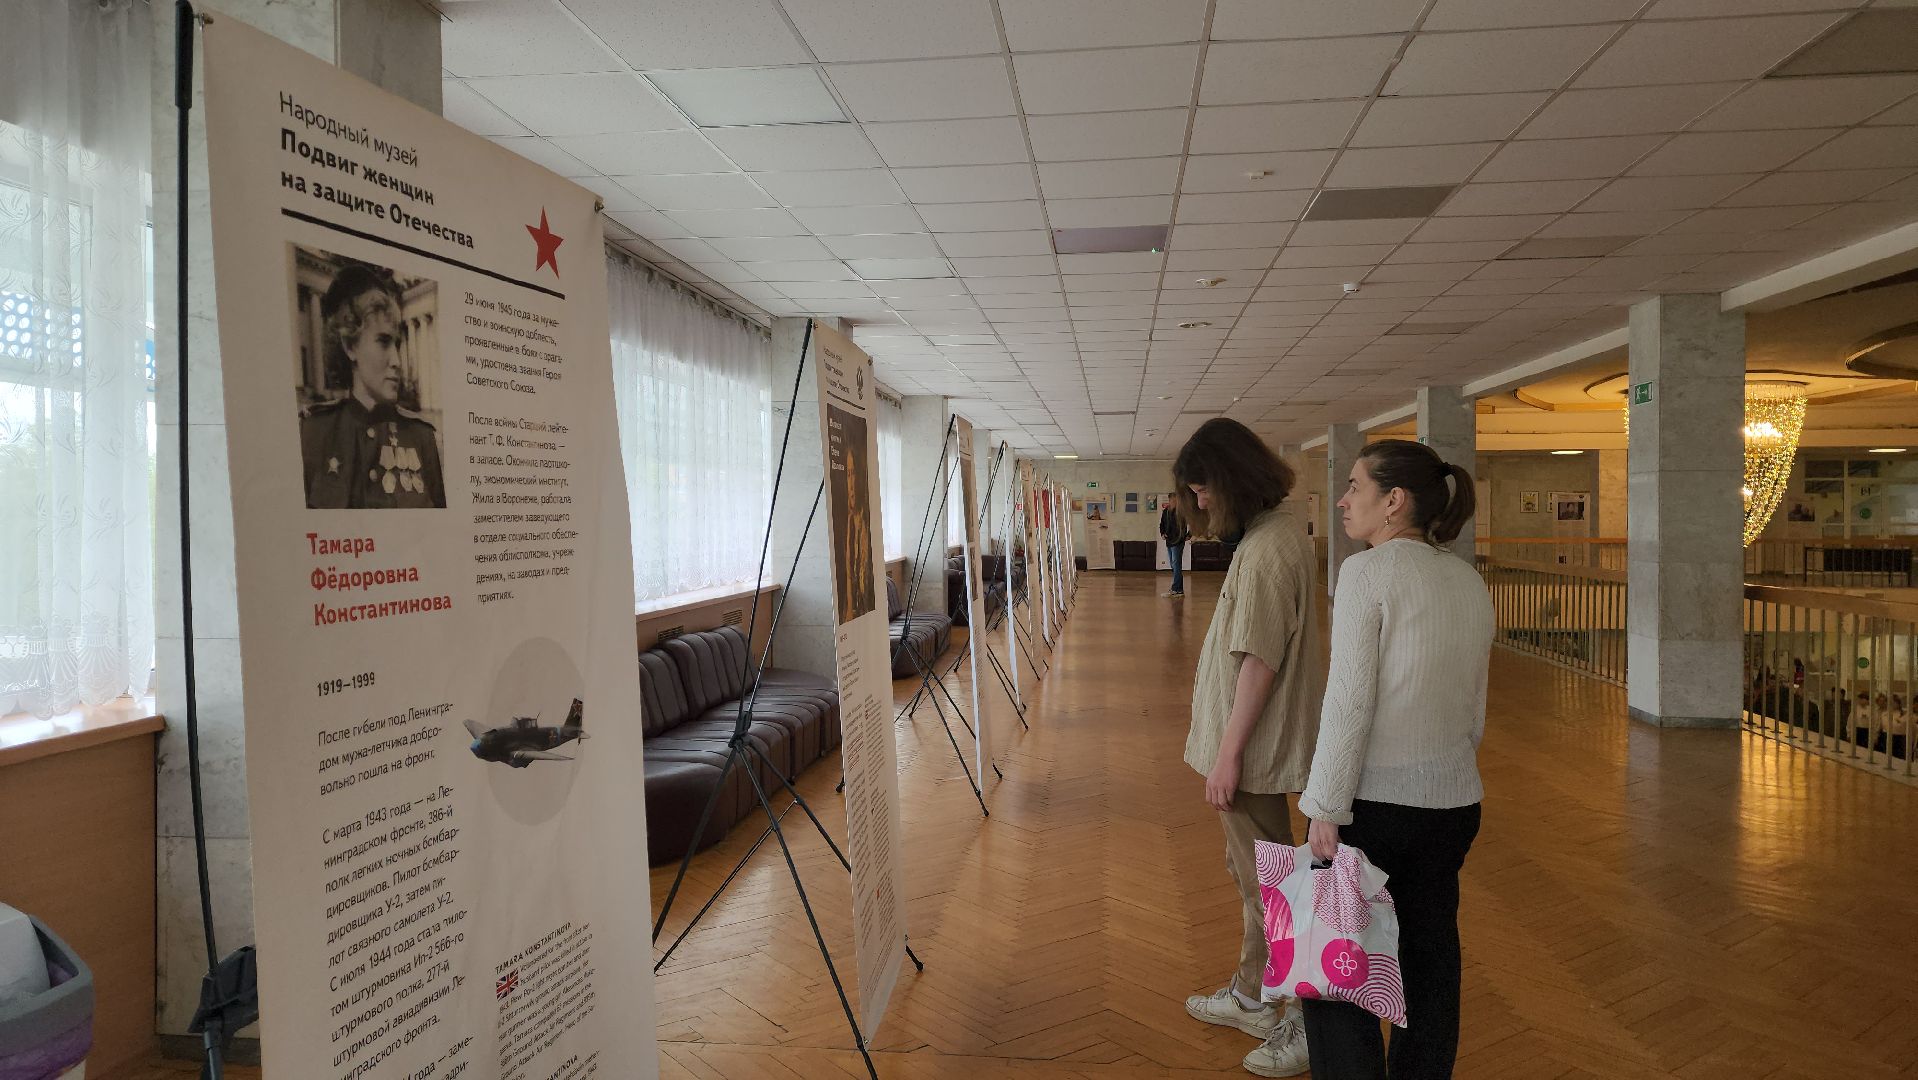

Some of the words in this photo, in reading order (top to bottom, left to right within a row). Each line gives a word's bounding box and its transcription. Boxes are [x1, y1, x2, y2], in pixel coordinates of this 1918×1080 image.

[280, 92, 370, 149] Народный
[374, 137, 418, 167] музей
[282, 129, 359, 176] Подвиг
[364, 158, 434, 205] женщин
[282, 172, 307, 194] на
[313, 180, 384, 220] защите
[390, 204, 474, 249] Отечества
[465, 292, 474, 304] 29
[476, 299, 495, 310] июня
[498, 302, 512, 315] 1945
[514, 309, 530, 320] года
[465, 315, 481, 326] ство
[490, 321, 524, 338] воинскую
[465, 335, 513, 353] проявленные
[466, 355, 478, 366] ми,
[481, 358, 517, 373] удостоена
[466, 372, 508, 390] Советского
[510, 380, 536, 394] Союза.
[468, 412, 492, 426] После
[494, 417, 518, 428] войны
[470, 434, 487, 445] нант
[507, 436, 556, 450] Константинова
[477, 456, 504, 466] запасе.
[484, 475, 537, 485] экономический
[472, 492, 494, 504] Жила
[474, 514, 523, 524] заместителем
[526, 513, 570, 524] заведующего
[306, 533, 375, 558] Тамара
[480, 532, 506, 544] отделе
[475, 554, 498, 563] чения
[517, 567, 545, 579] заводах
[311, 567, 418, 591] Фёдоровна
[314, 596, 451, 626] Константинова
[318, 729, 350, 746] После
[353, 717, 386, 737] гибели
[388, 713, 406, 727] под
[408, 702, 453, 722] Ленингра-
[319, 758, 339, 774] дом
[342, 736, 408, 766] мужа-летчика
[410, 726, 442, 746] добро-
[320, 775, 355, 796] вольно
[358, 763, 388, 783] пошла
[391, 759, 402, 772] на
[322, 829, 330, 844] С
[333, 821, 362, 840] марта
[366, 807, 387, 827] 1943
[390, 802, 411, 819] года
[324, 834, 387, 870] нинградском
[390, 820, 426, 843] фронте,
[325, 875, 350, 894] полк
[352, 861, 383, 882] легких
[386, 844, 421, 866] ночных
[423, 826, 460, 849] бомбар-
[327, 882, 390, 920] дировщиков.
[393, 866, 421, 886] Пилот
[423, 849, 460, 872] бомбар-
[327, 905, 383, 945] дировщика
[385, 893, 403, 913] У-2,
[406, 883, 431, 904] затем
[329, 953, 345, 969] лот
[348, 926, 391, 957] связного
[394, 901, 435, 932] самолета
[495, 952, 523, 975] TAMARA
[525, 921, 572, 956] KONSTANTINOVA
[330, 975, 338, 992] С
[340, 964, 366, 986] июля
[369, 945, 392, 969] 1944
[393, 936, 415, 955] года
[417, 922, 441, 943] стала
[330, 998, 349, 1017] том
[352, 962, 412, 1004] штурмовика
[435, 932, 464, 956] 566-го
[332, 996, 393, 1043] штурмового
[396, 978, 424, 1002] полка,
[427, 960, 450, 984] 277-й
[333, 1020, 390, 1067] штурмовой
[392, 985, 450, 1029] авиадивизии
[404, 1015, 441, 1046] фронта.
[449, 1036, 474, 1059] заме-
